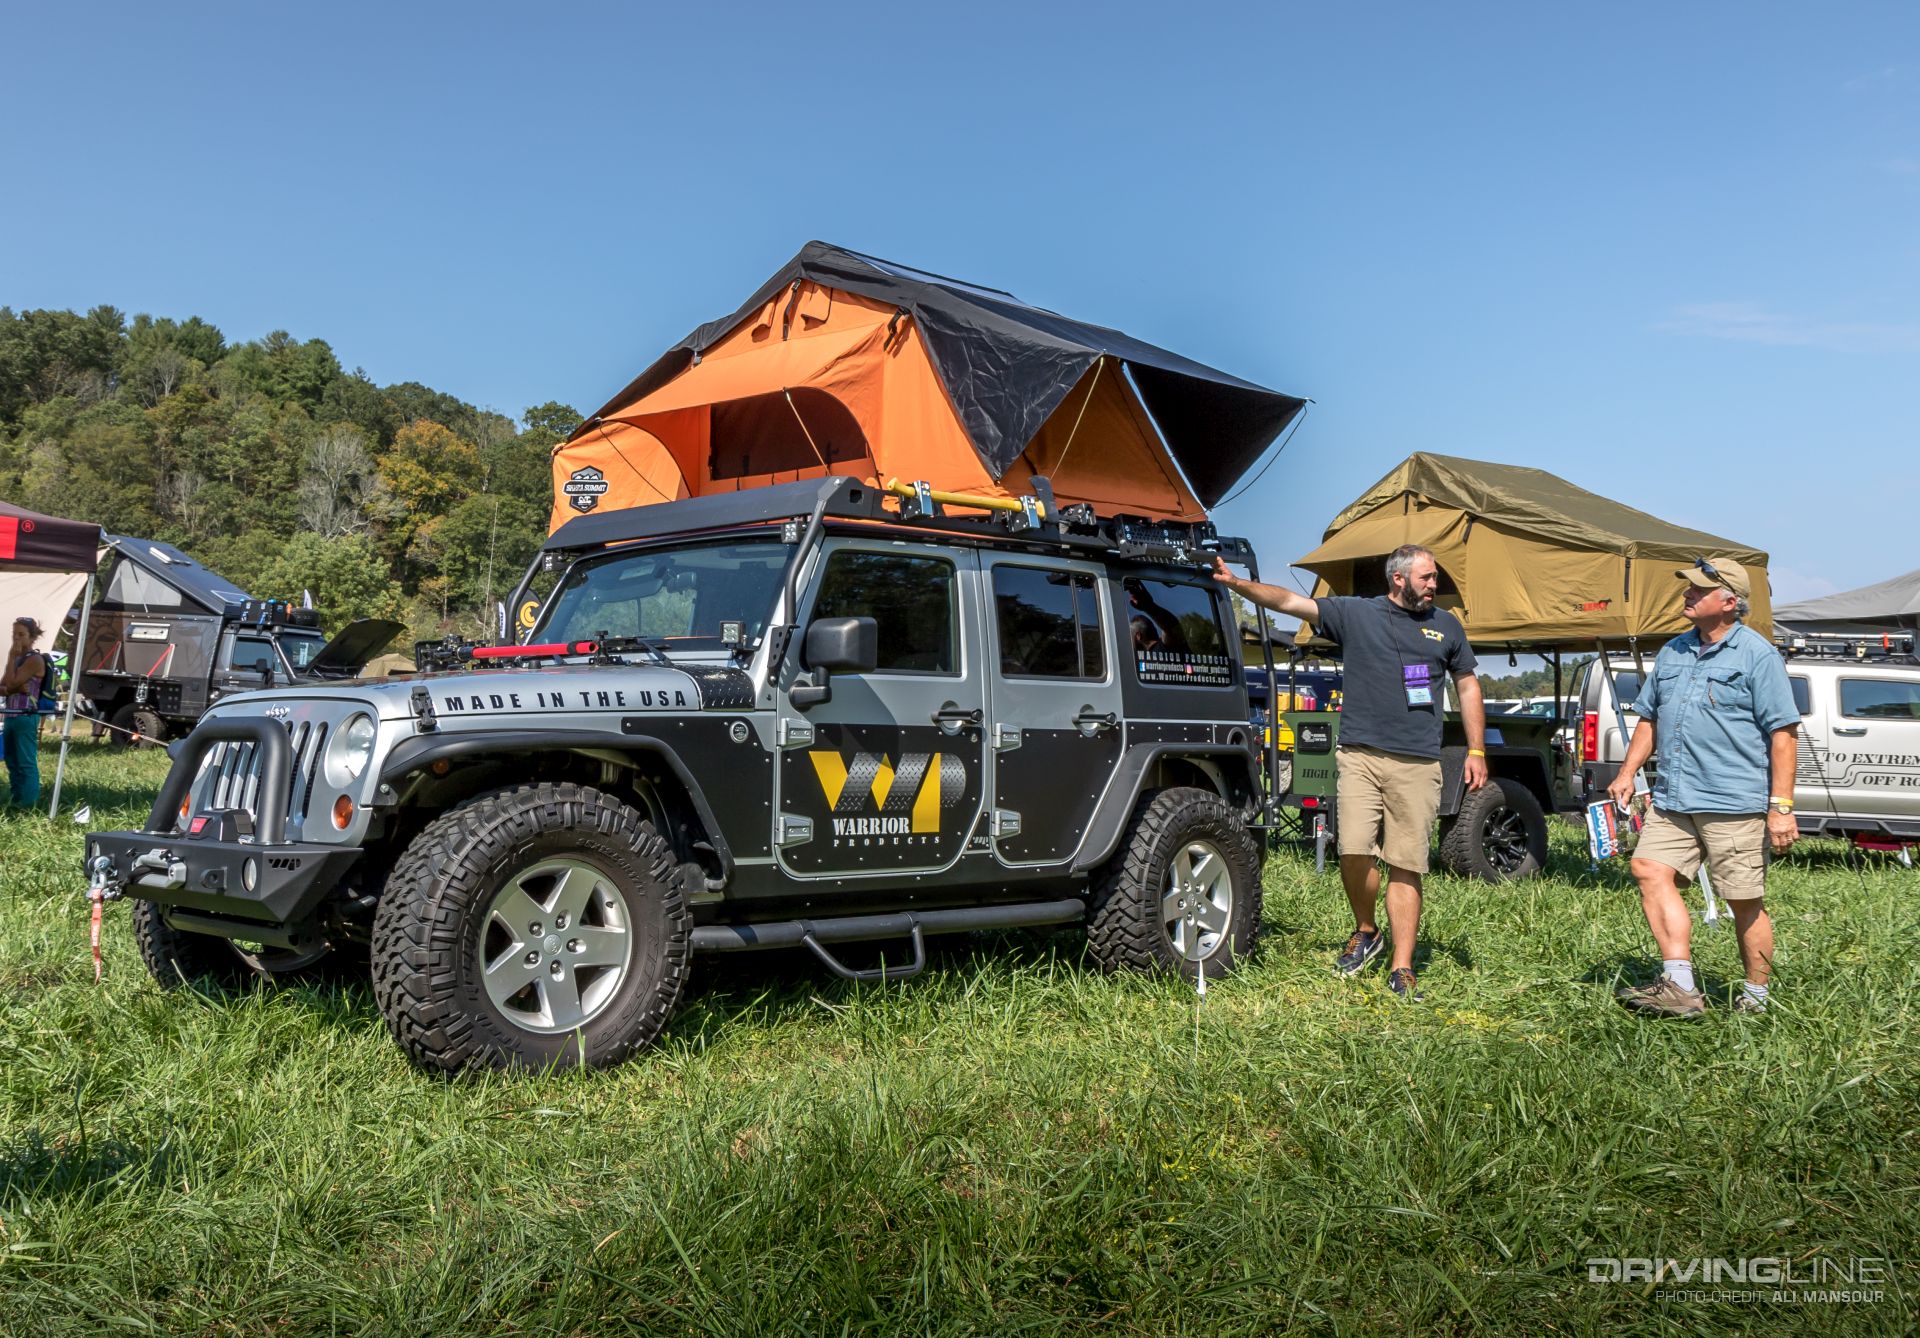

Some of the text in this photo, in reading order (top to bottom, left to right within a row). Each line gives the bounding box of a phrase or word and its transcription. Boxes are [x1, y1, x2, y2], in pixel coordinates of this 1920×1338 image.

[1137, 650, 1229, 666] WARRIOR PRODUCTS
[1140, 672, 1231, 684] www.WarriorProducts.com
[444, 690, 687, 712] MADE IN THE USA
[1822, 752, 1847, 763] TO
[1302, 768, 1329, 779] HIGH
[1862, 775, 1896, 786] OFF
[832, 817, 910, 836] WARRIOR
[1595, 805, 1611, 857] Outdoor
[833, 836, 940, 847] PRODUCTS
